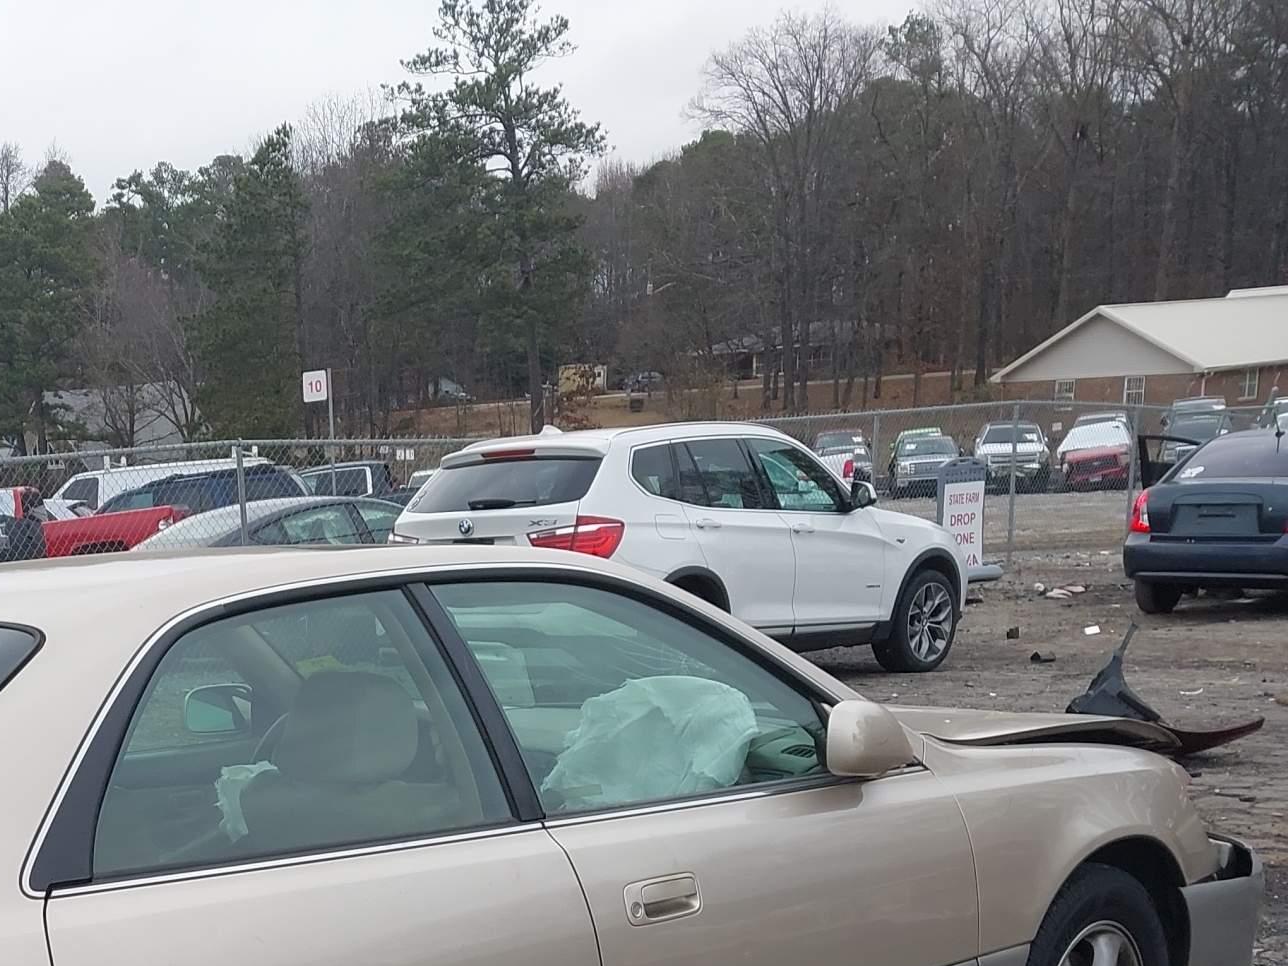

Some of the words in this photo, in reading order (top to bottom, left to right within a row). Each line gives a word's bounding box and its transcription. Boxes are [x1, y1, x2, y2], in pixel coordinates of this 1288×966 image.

[308, 380, 322, 393] 10
[949, 493, 964, 505] STATE
[965, 491, 979, 504] FARM
[950, 512, 976, 527] DROP
[953, 532, 975, 546] ONE
